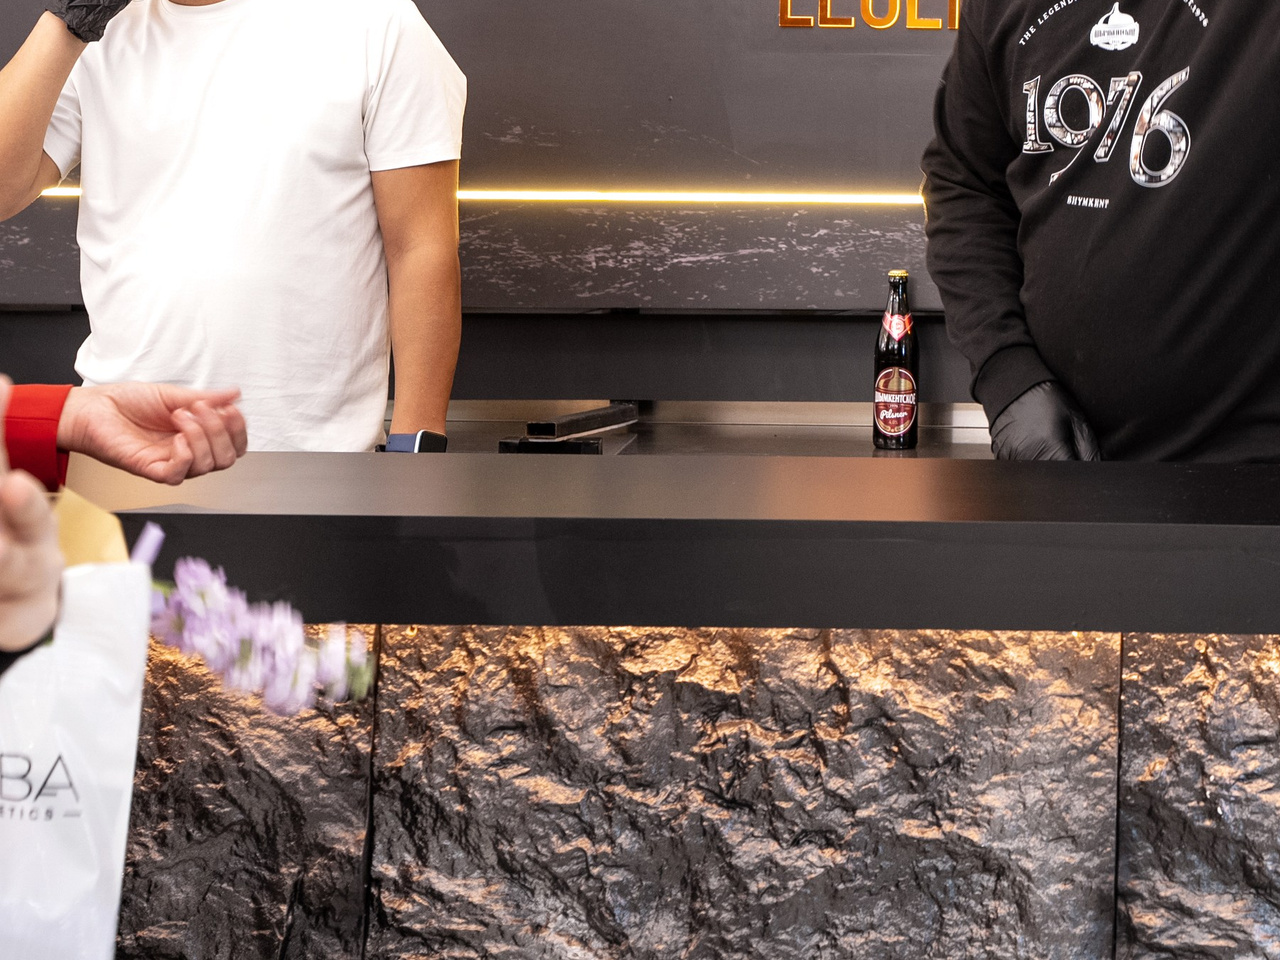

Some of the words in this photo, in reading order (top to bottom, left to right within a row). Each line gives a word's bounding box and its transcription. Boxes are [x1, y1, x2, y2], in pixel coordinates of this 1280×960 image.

[1019, 25, 1036, 46] THE
[1022, 66, 1191, 188] 1976
[880, 408, 908, 420] Pilsner
